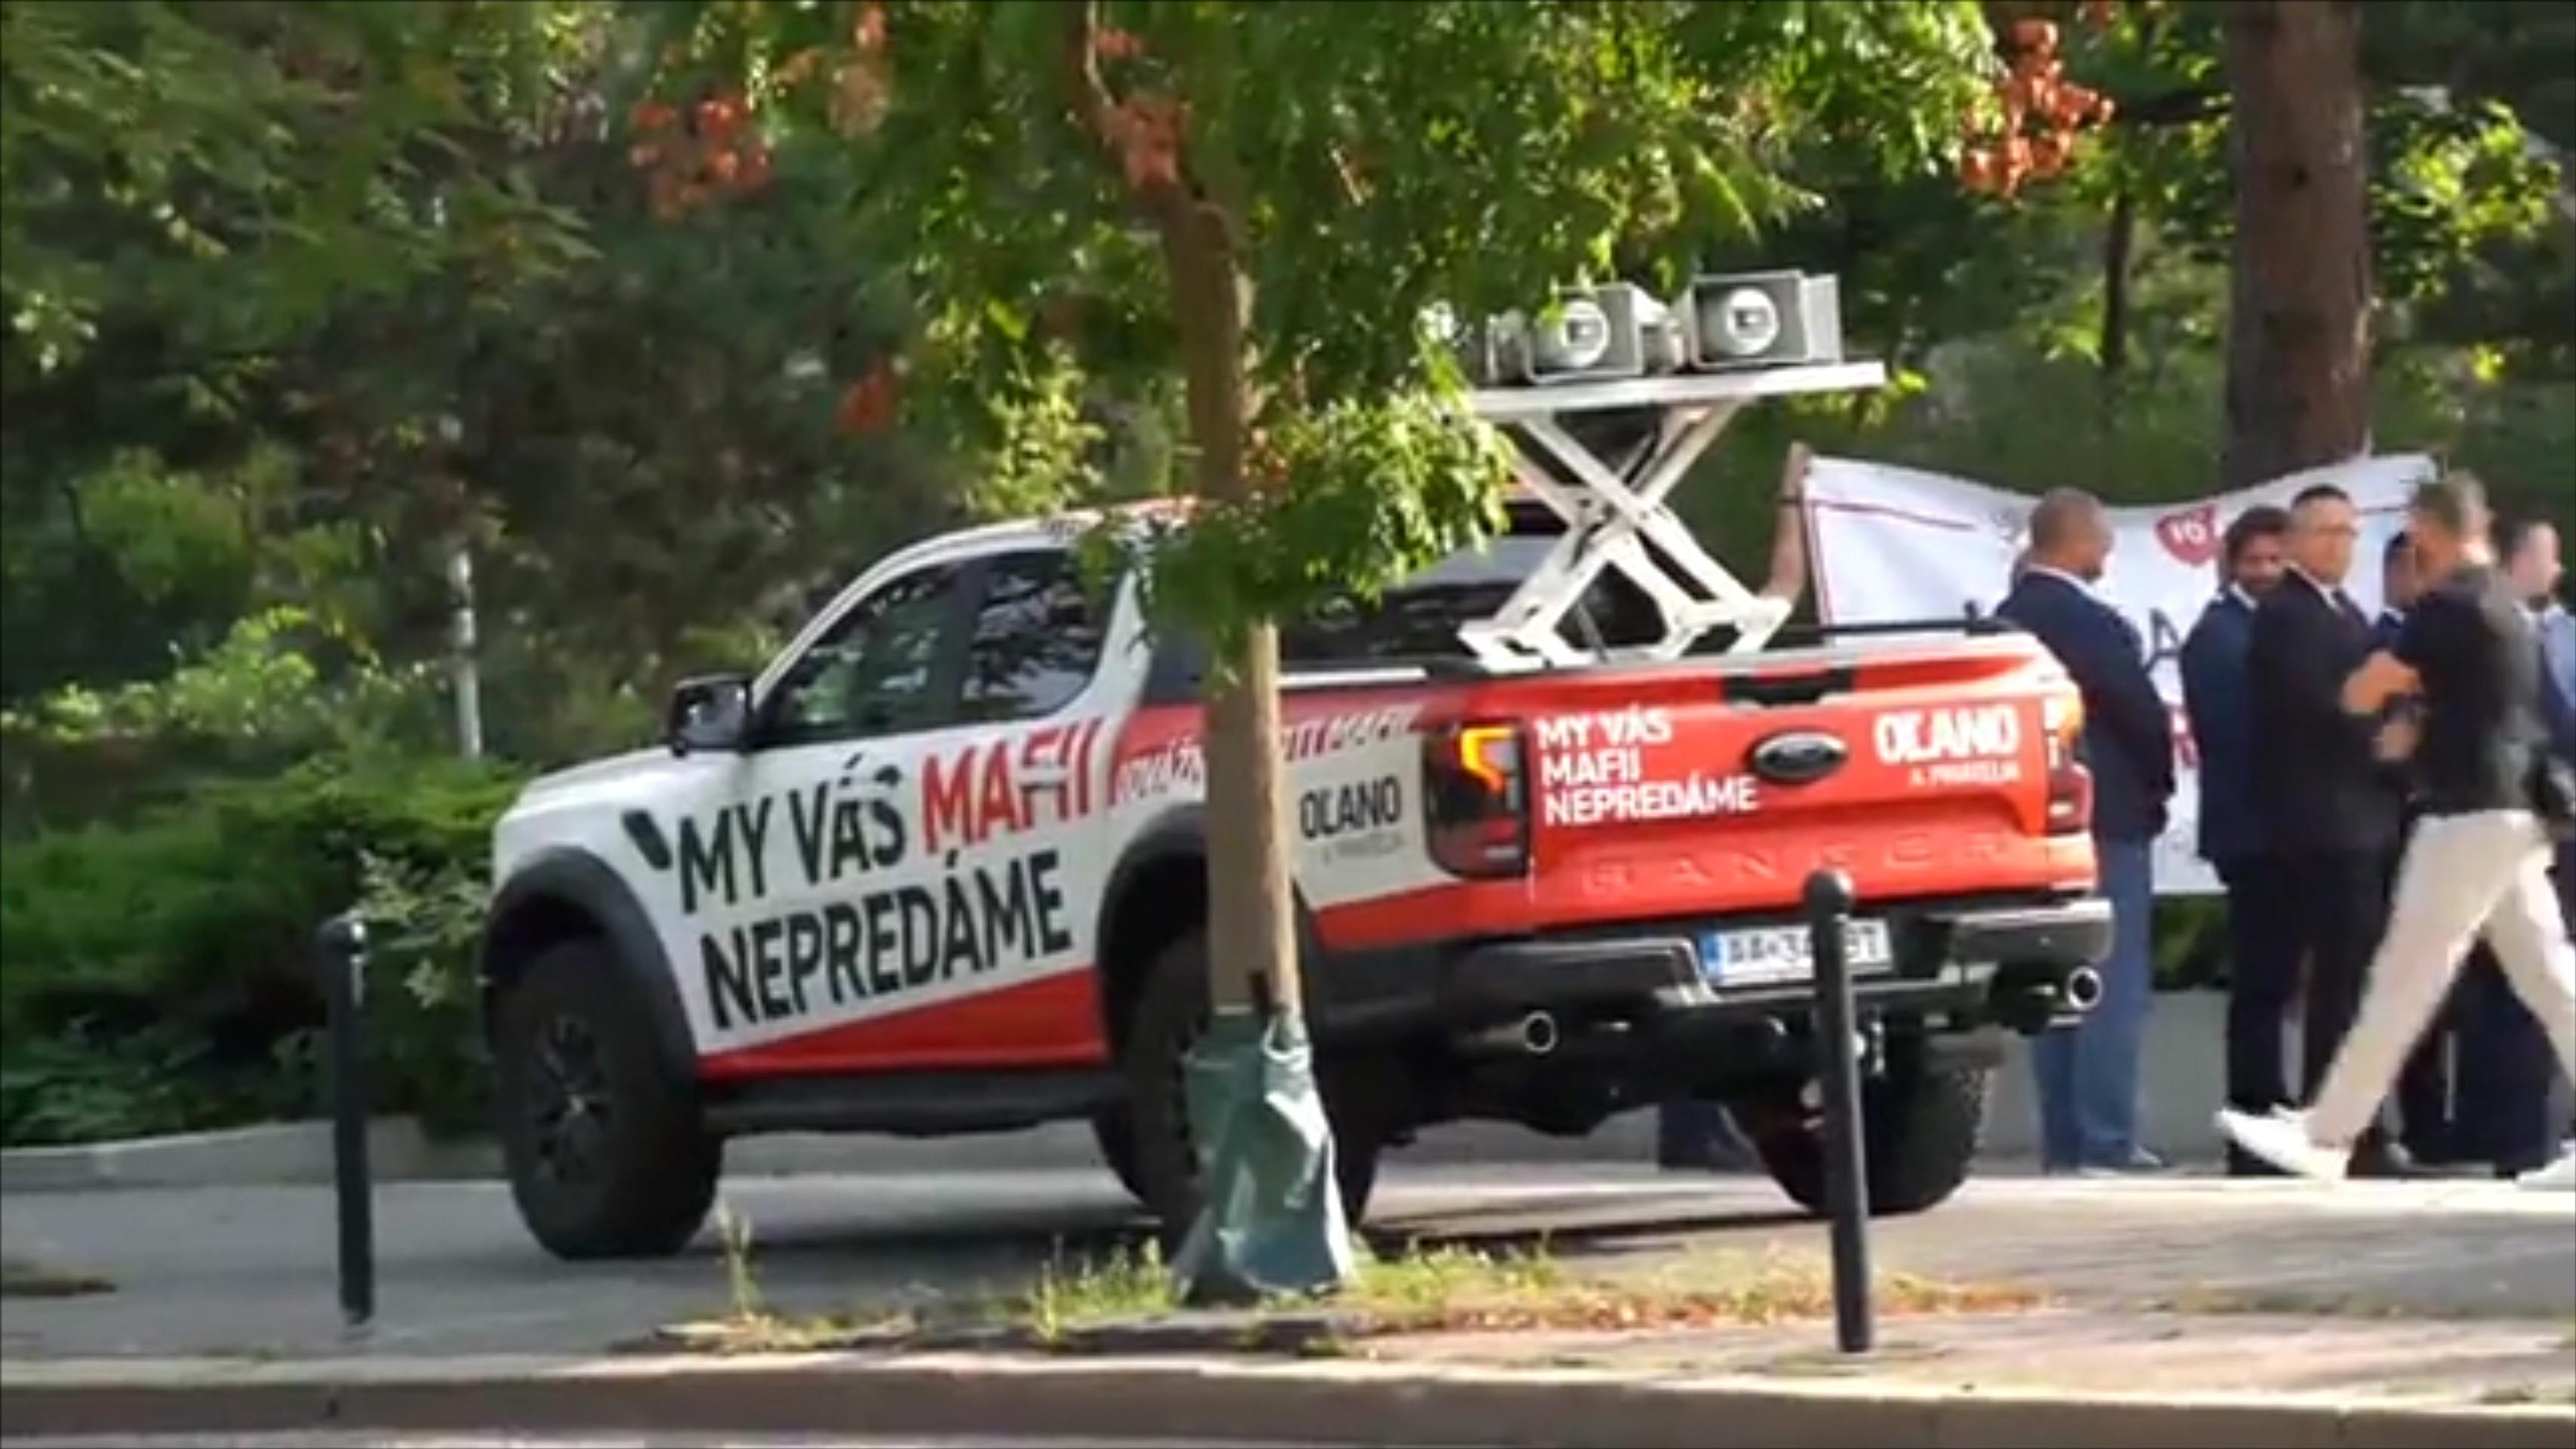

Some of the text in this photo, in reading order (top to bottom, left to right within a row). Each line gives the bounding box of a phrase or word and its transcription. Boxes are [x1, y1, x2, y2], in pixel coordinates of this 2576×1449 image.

[1533, 703, 1673, 749] MY VÁS
[1540, 747, 1641, 788] MAFII
[680, 795, 774, 914] MY
[789, 752, 907, 885] VÁS
[921, 717, 1105, 854] MAFII
[1543, 771, 1761, 826] NEPREDÁME
[700, 848, 1073, 1030] NEPREDÁME
